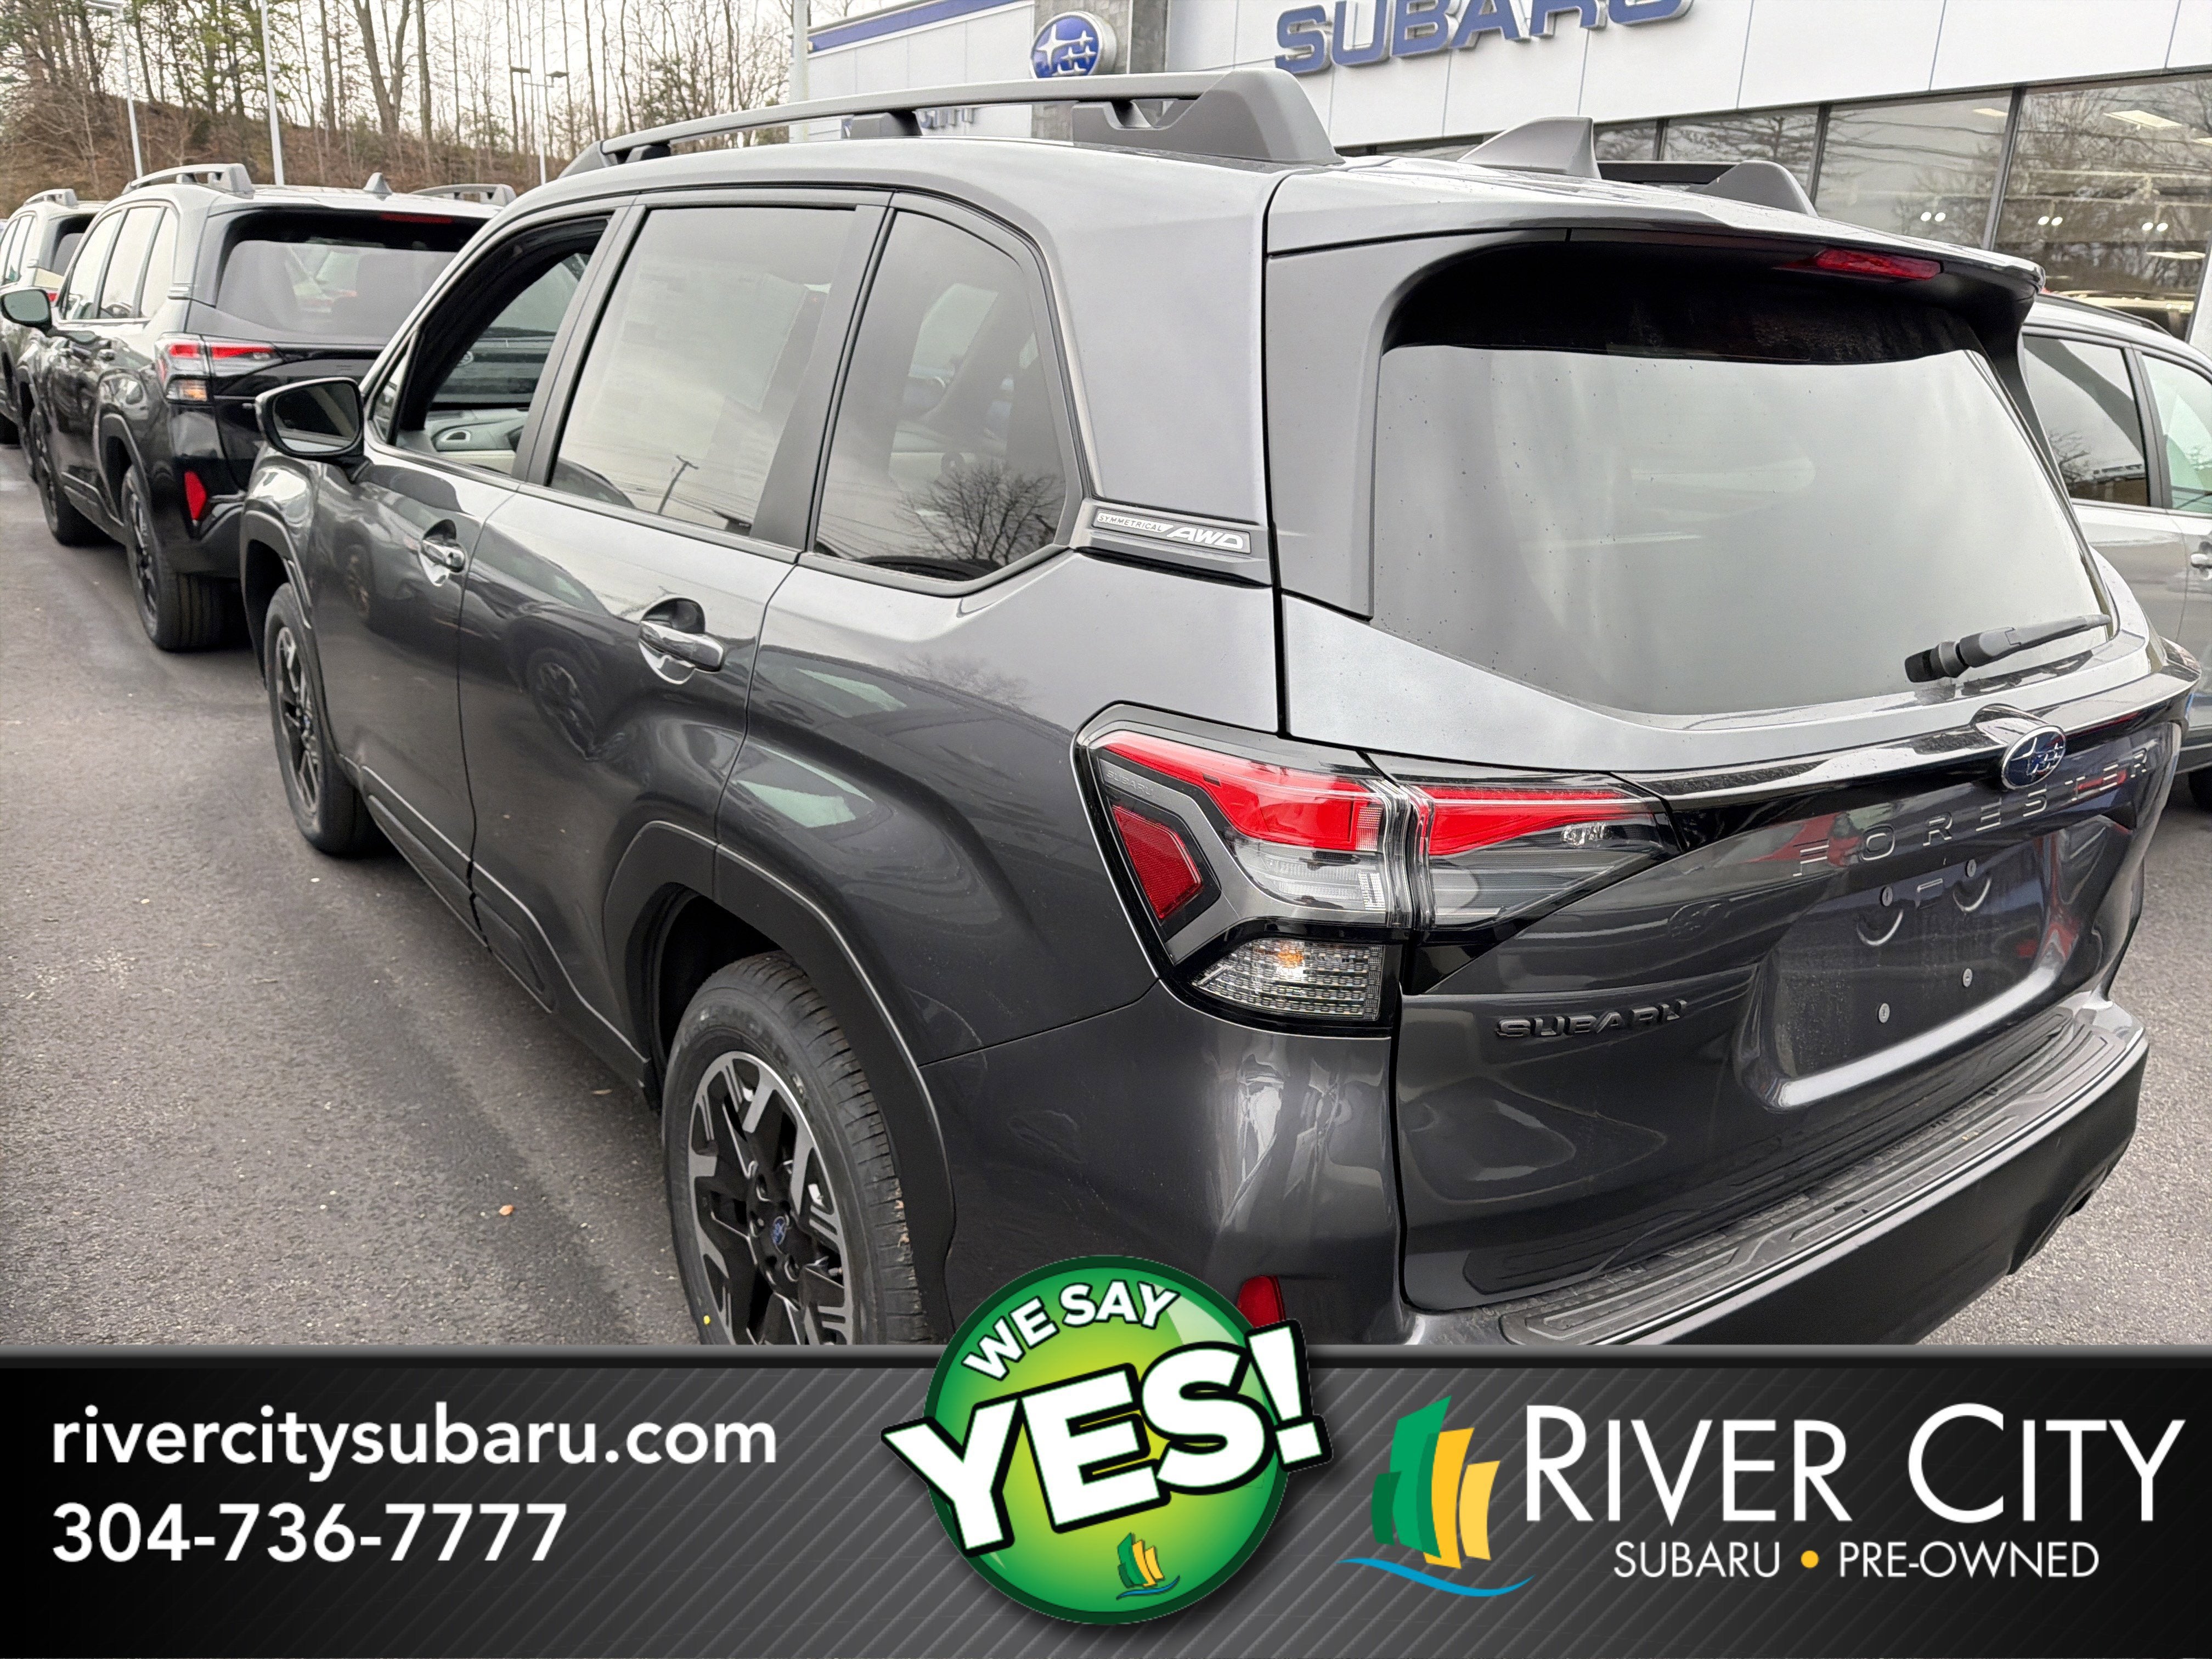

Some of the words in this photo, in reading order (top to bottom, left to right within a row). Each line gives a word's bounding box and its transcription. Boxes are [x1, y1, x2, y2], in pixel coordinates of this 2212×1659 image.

[1098, 514, 1164, 533] SYMMETRICAL
[1166, 526, 1244, 550] AWD
[1105, 769, 1154, 796] SUBARU
[1792, 746, 2149, 877] FORESTER
[1496, 999, 1688, 1037] SUBARU
